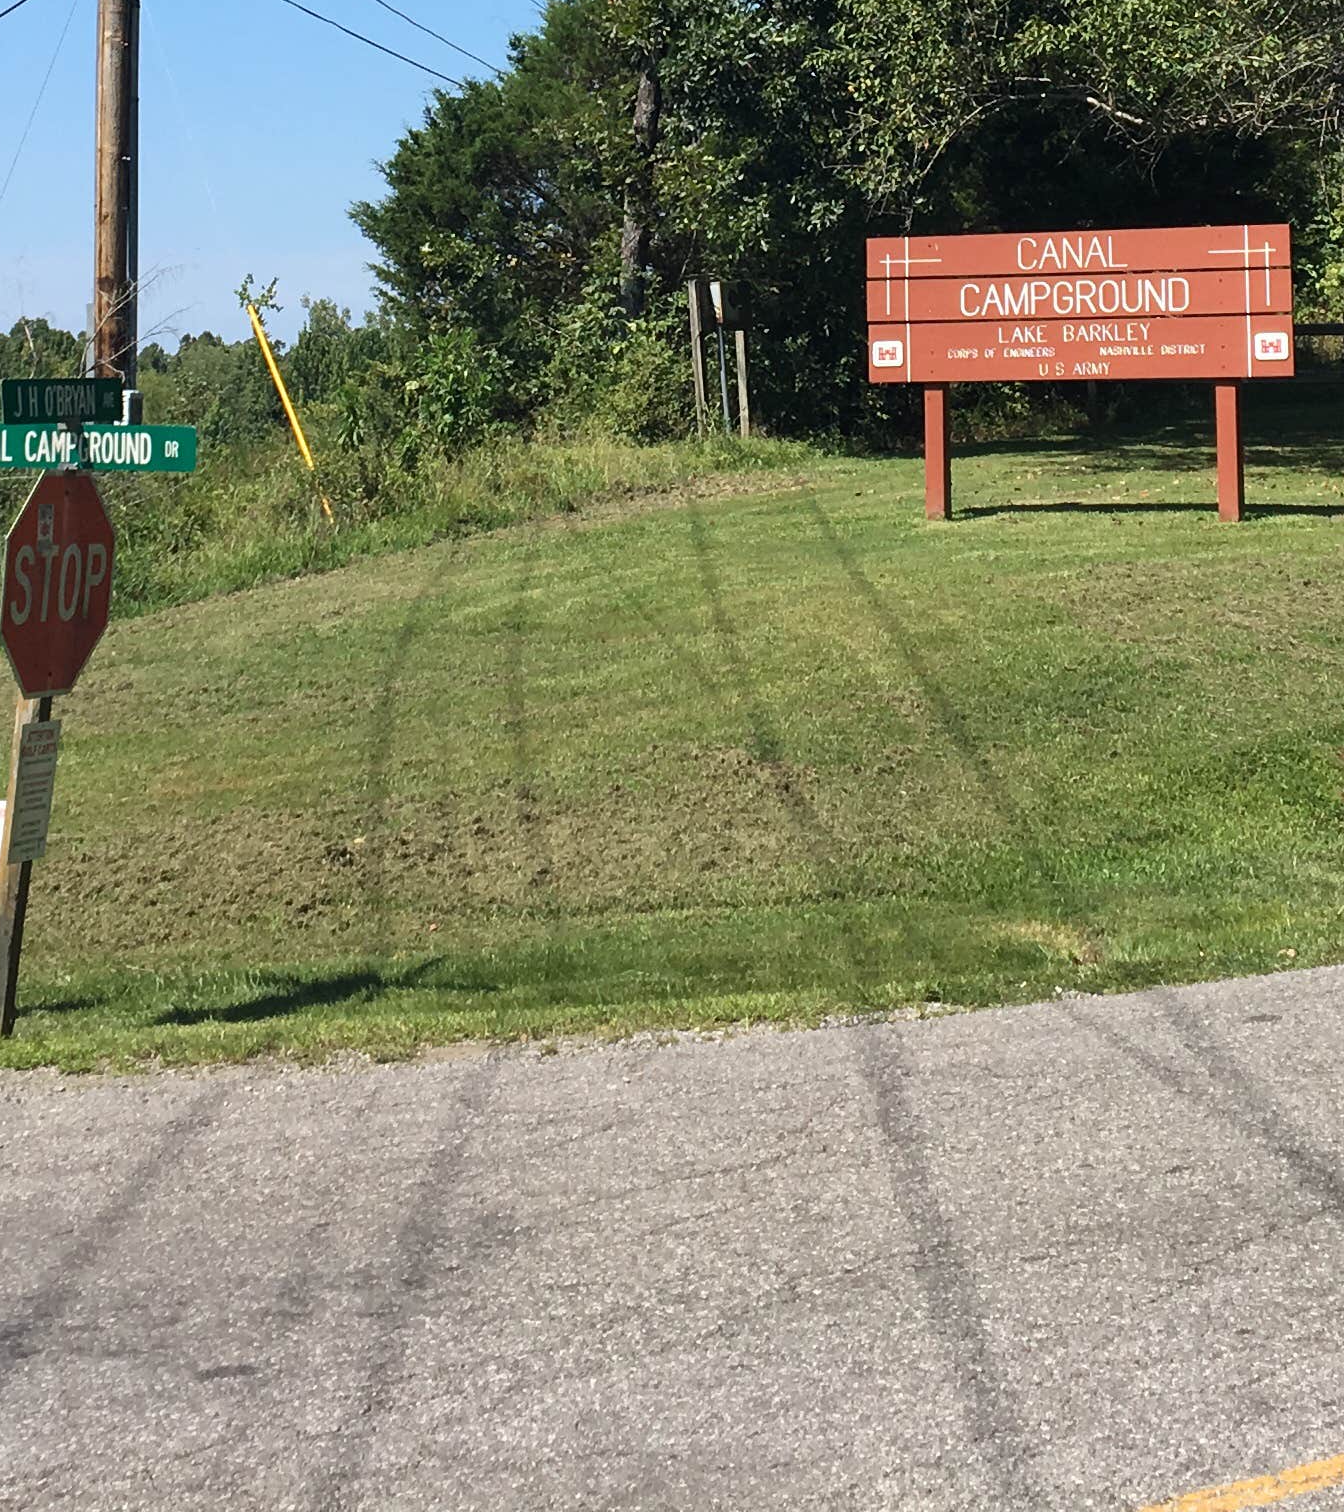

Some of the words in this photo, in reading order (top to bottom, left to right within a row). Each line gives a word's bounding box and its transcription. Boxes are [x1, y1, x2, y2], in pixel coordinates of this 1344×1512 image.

[1017, 236, 1128, 270] CANAL
[960, 277, 1190, 317] CAMPGROUND
[998, 325, 1048, 343] LAKE
[1063, 322, 1151, 342] BARKLEY
[947, 348, 979, 359] CORPS
[984, 348, 995, 358] OF
[1003, 346, 1056, 357] ENGINEERS
[1099, 344, 1154, 355] NASHVILLE
[1161, 344, 1206, 354] DISTRICT
[1038, 363, 1049, 376] U
[1055, 362, 1065, 376] S
[1072, 362, 1111, 375] ARMY
[14, 387, 23, 417] J
[28, 386, 39, 417] H
[44, 385, 96, 417] O'BRYAN
[24, 430, 152, 465] CAMPGROUND
[164, 440, 179, 458] DR
[10, 543, 106, 626] STOP
